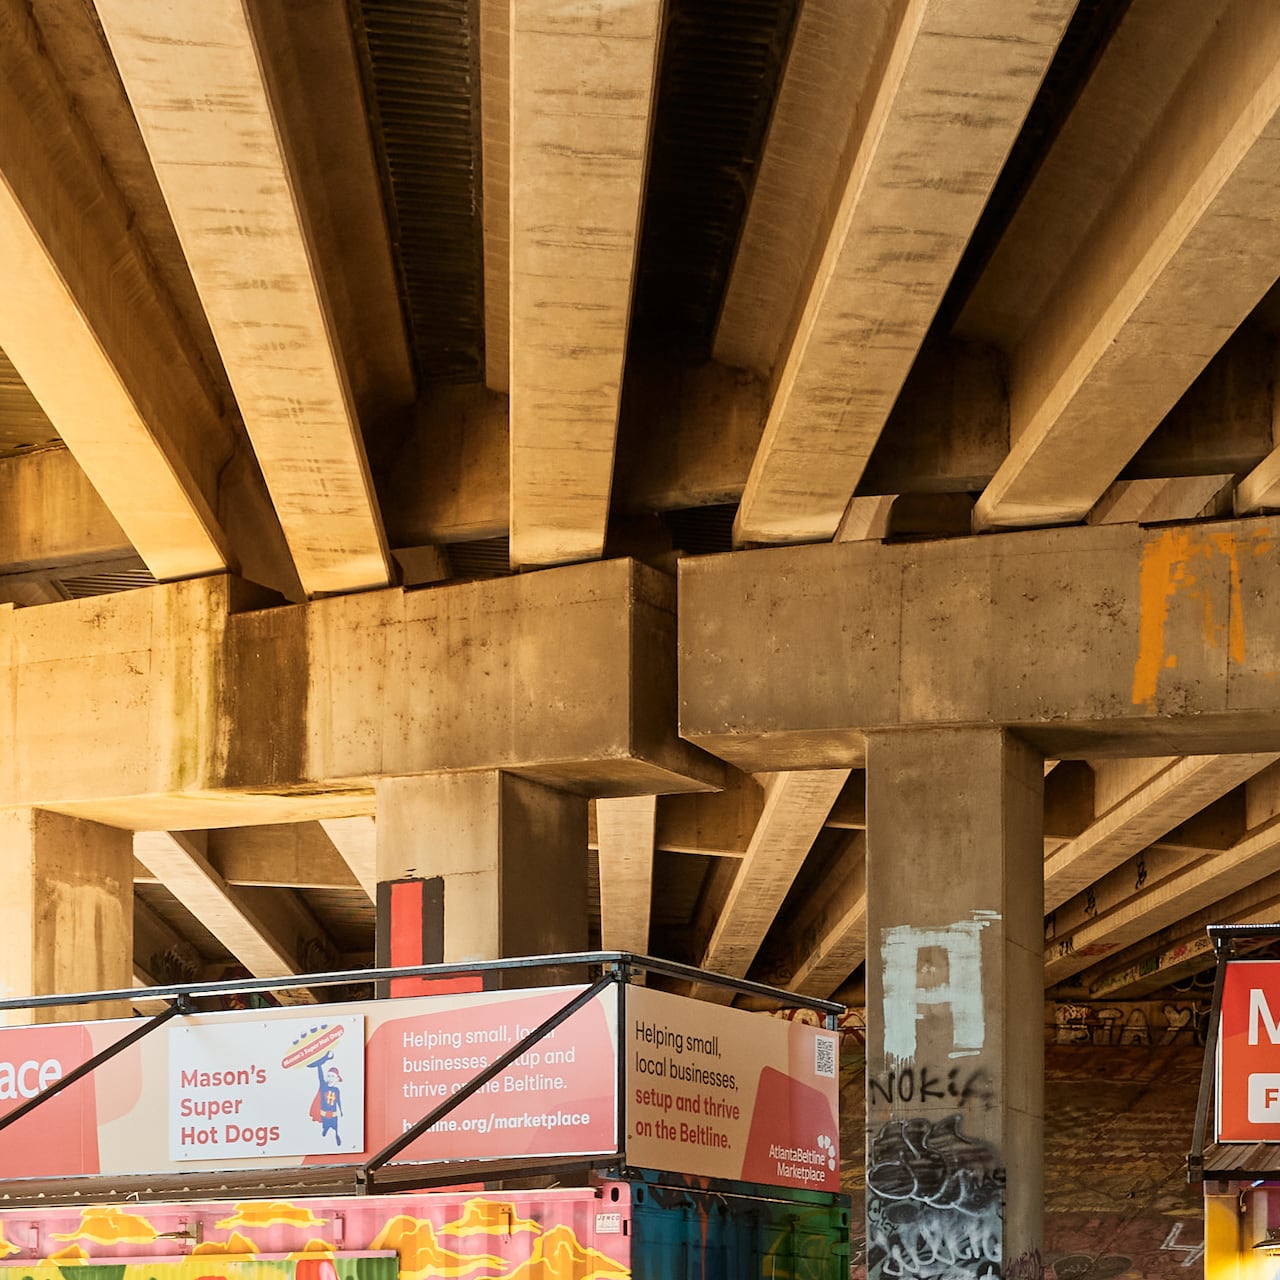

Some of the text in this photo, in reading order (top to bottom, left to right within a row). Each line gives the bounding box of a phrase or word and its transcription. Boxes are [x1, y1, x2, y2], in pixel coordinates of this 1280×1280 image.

[402, 1024, 556, 1050] Helping small, lol
[635, 1021, 722, 1058] Helping small,
[544, 1047, 575, 1064] and
[180, 1065, 267, 1088] Mason's
[635, 1051, 739, 1092] local businesses,
[402, 1080, 447, 1098] thrive
[476, 1080, 500, 1094] he
[504, 1075, 568, 1093] Beltline.
[180, 1098, 243, 1121] Super
[635, 1088, 740, 1121] setup and thrive
[402, 1111, 590, 1133] bline.org/marketplace
[180, 1124, 280, 1148] Hot Dogs
[635, 1119, 731, 1149] on the Beltline.
[769, 1144, 825, 1167] AtlantaBeltline
[776, 1161, 825, 1184] Marketplace
